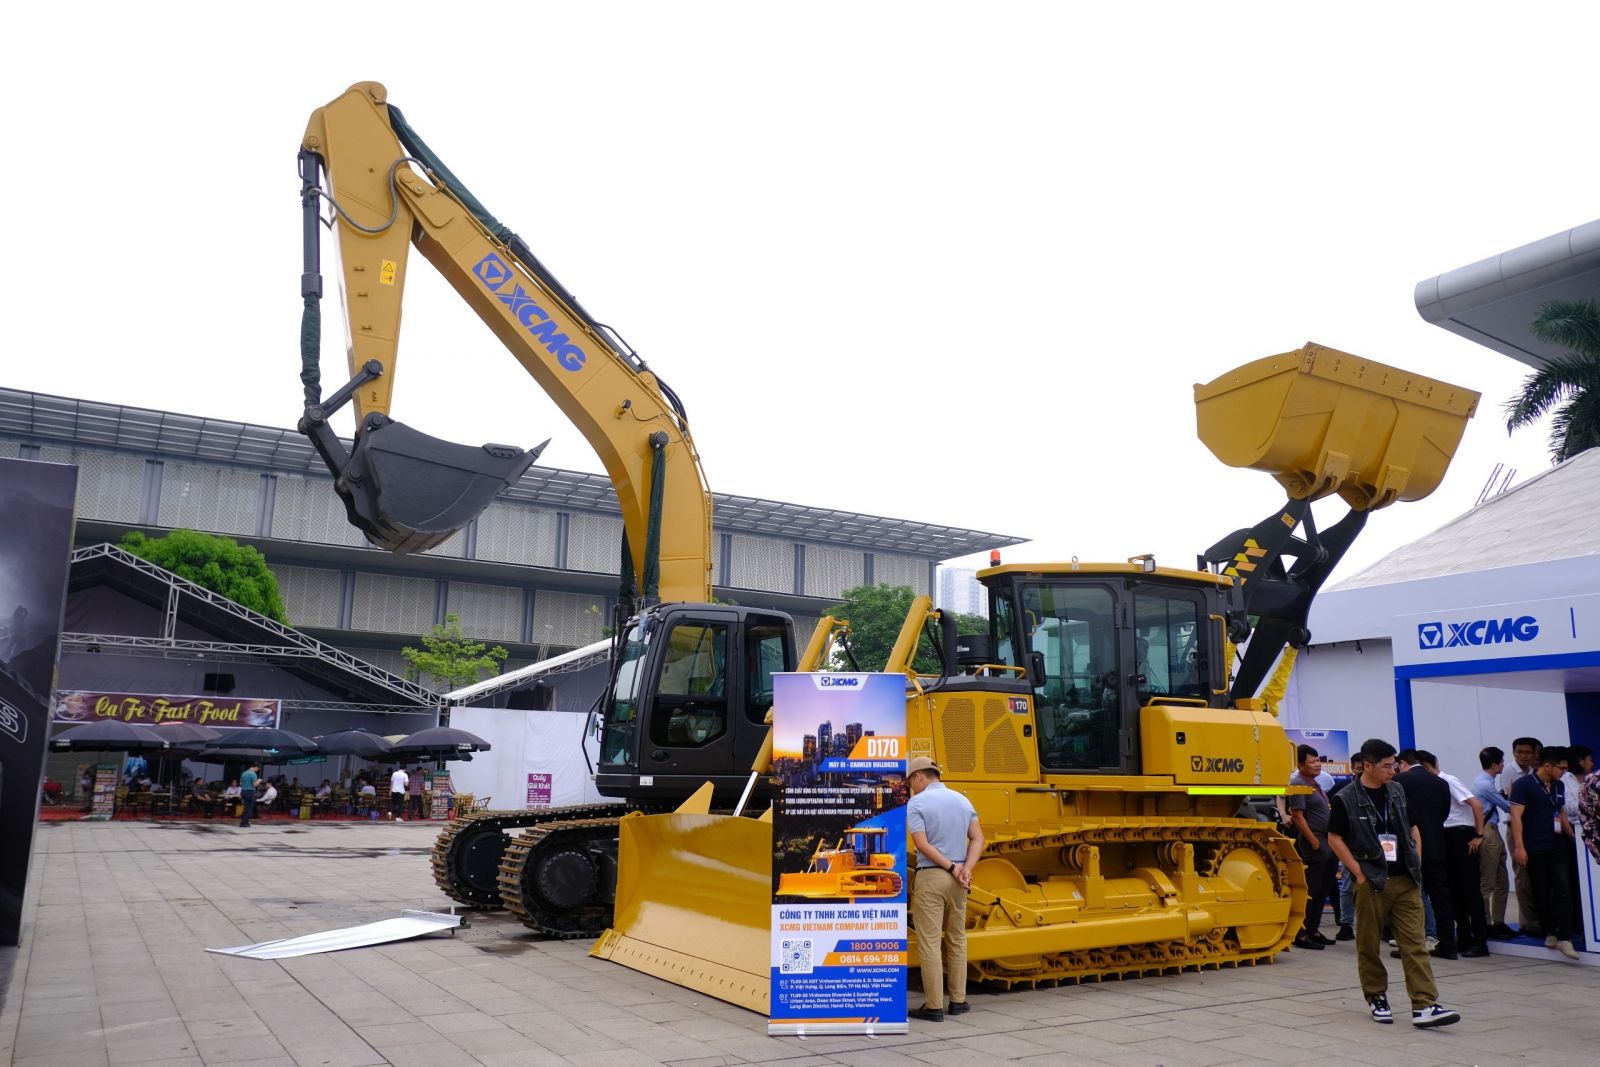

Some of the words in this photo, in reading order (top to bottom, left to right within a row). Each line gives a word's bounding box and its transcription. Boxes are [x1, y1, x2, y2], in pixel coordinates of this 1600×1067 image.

[495, 283, 586, 371] XCMG
[1445, 616, 1539, 647] XCMG
[831, 678, 858, 686] XCMG
[151, 699, 191, 722] Fast
[194, 700, 241, 723] Food
[867, 738, 899, 758] D170
[1205, 758, 1244, 773] XCMG
[780, 909, 801, 919] CÔNG
[804, 910, 812, 919] TY
[815, 910, 835, 919] TNHH
[837, 910, 859, 919] XCMG
[862, 908, 878, 920] VIỆT
[880, 910, 898, 918] NAM
[780, 923, 800, 931] XCMG
[803, 923, 833, 931] VIETNAM
[835, 922, 868, 931] COMPANY
[871, 922, 898, 930] LIMITED
[851, 942, 872, 950] 1800
[875, 942, 899, 950] 9006
[840, 955, 861, 963] 0814
[864, 955, 880, 963] 694
